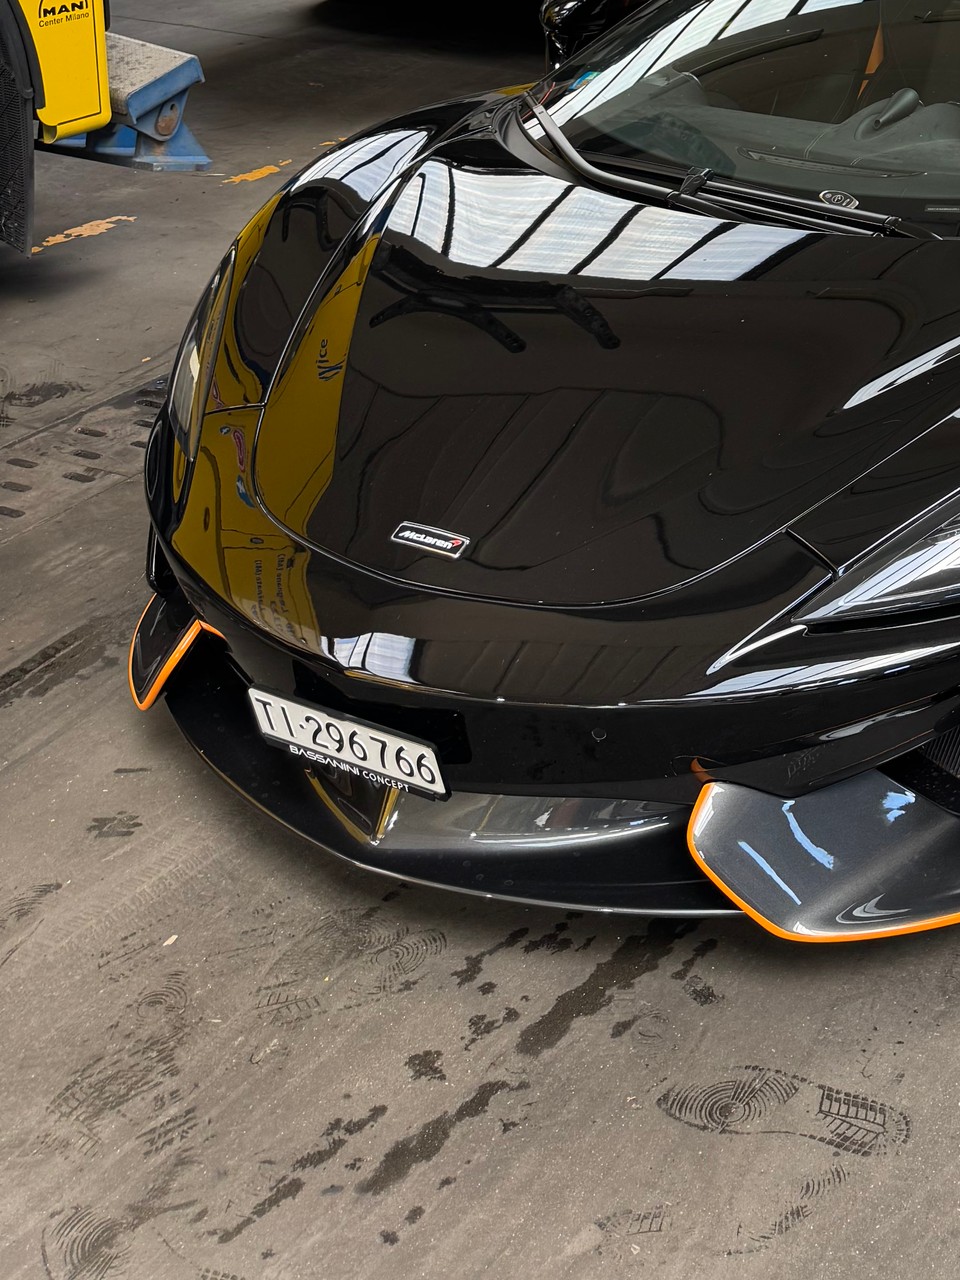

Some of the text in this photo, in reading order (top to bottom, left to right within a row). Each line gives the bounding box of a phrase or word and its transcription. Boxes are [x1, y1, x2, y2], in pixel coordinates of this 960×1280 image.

[42, 0, 84, 18] MAN
[38, 12, 90, 28] Center Milano
[398, 530, 454, 550] McLaren
[288, 744, 410, 793] BASSANINI CONCEPT
